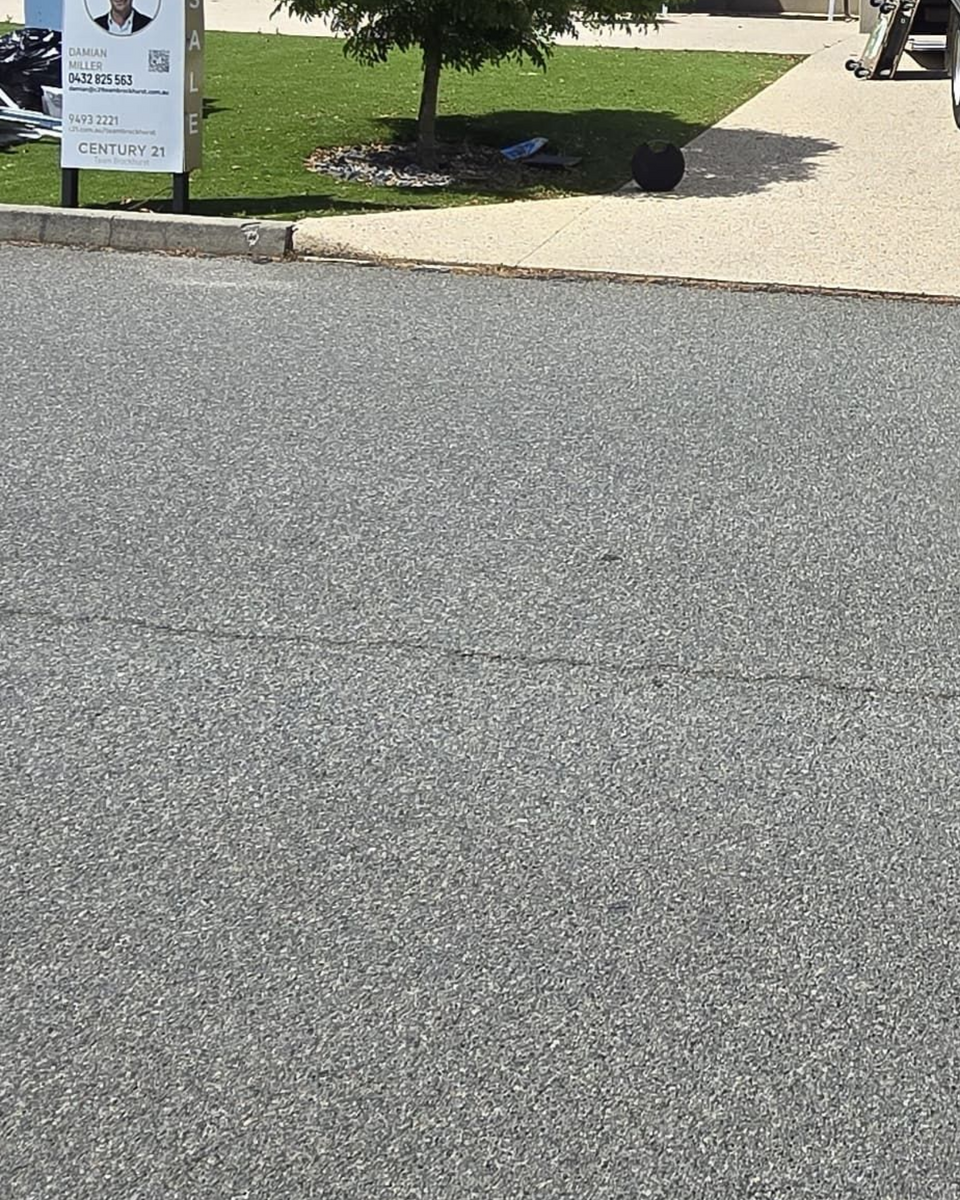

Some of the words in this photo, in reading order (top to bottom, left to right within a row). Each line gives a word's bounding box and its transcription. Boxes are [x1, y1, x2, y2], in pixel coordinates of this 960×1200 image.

[68, 47, 107, 58] DAMIAN
[68, 60, 102, 71] MILLER
[68, 72, 93, 85] 0432
[95, 73, 113, 85] 825
[114, 74, 133, 86] 563
[68, 114, 93, 125] 9493
[96, 115, 119, 126] 2221
[78, 142, 146, 157] CENTURY
[151, 146, 165, 158] 21
